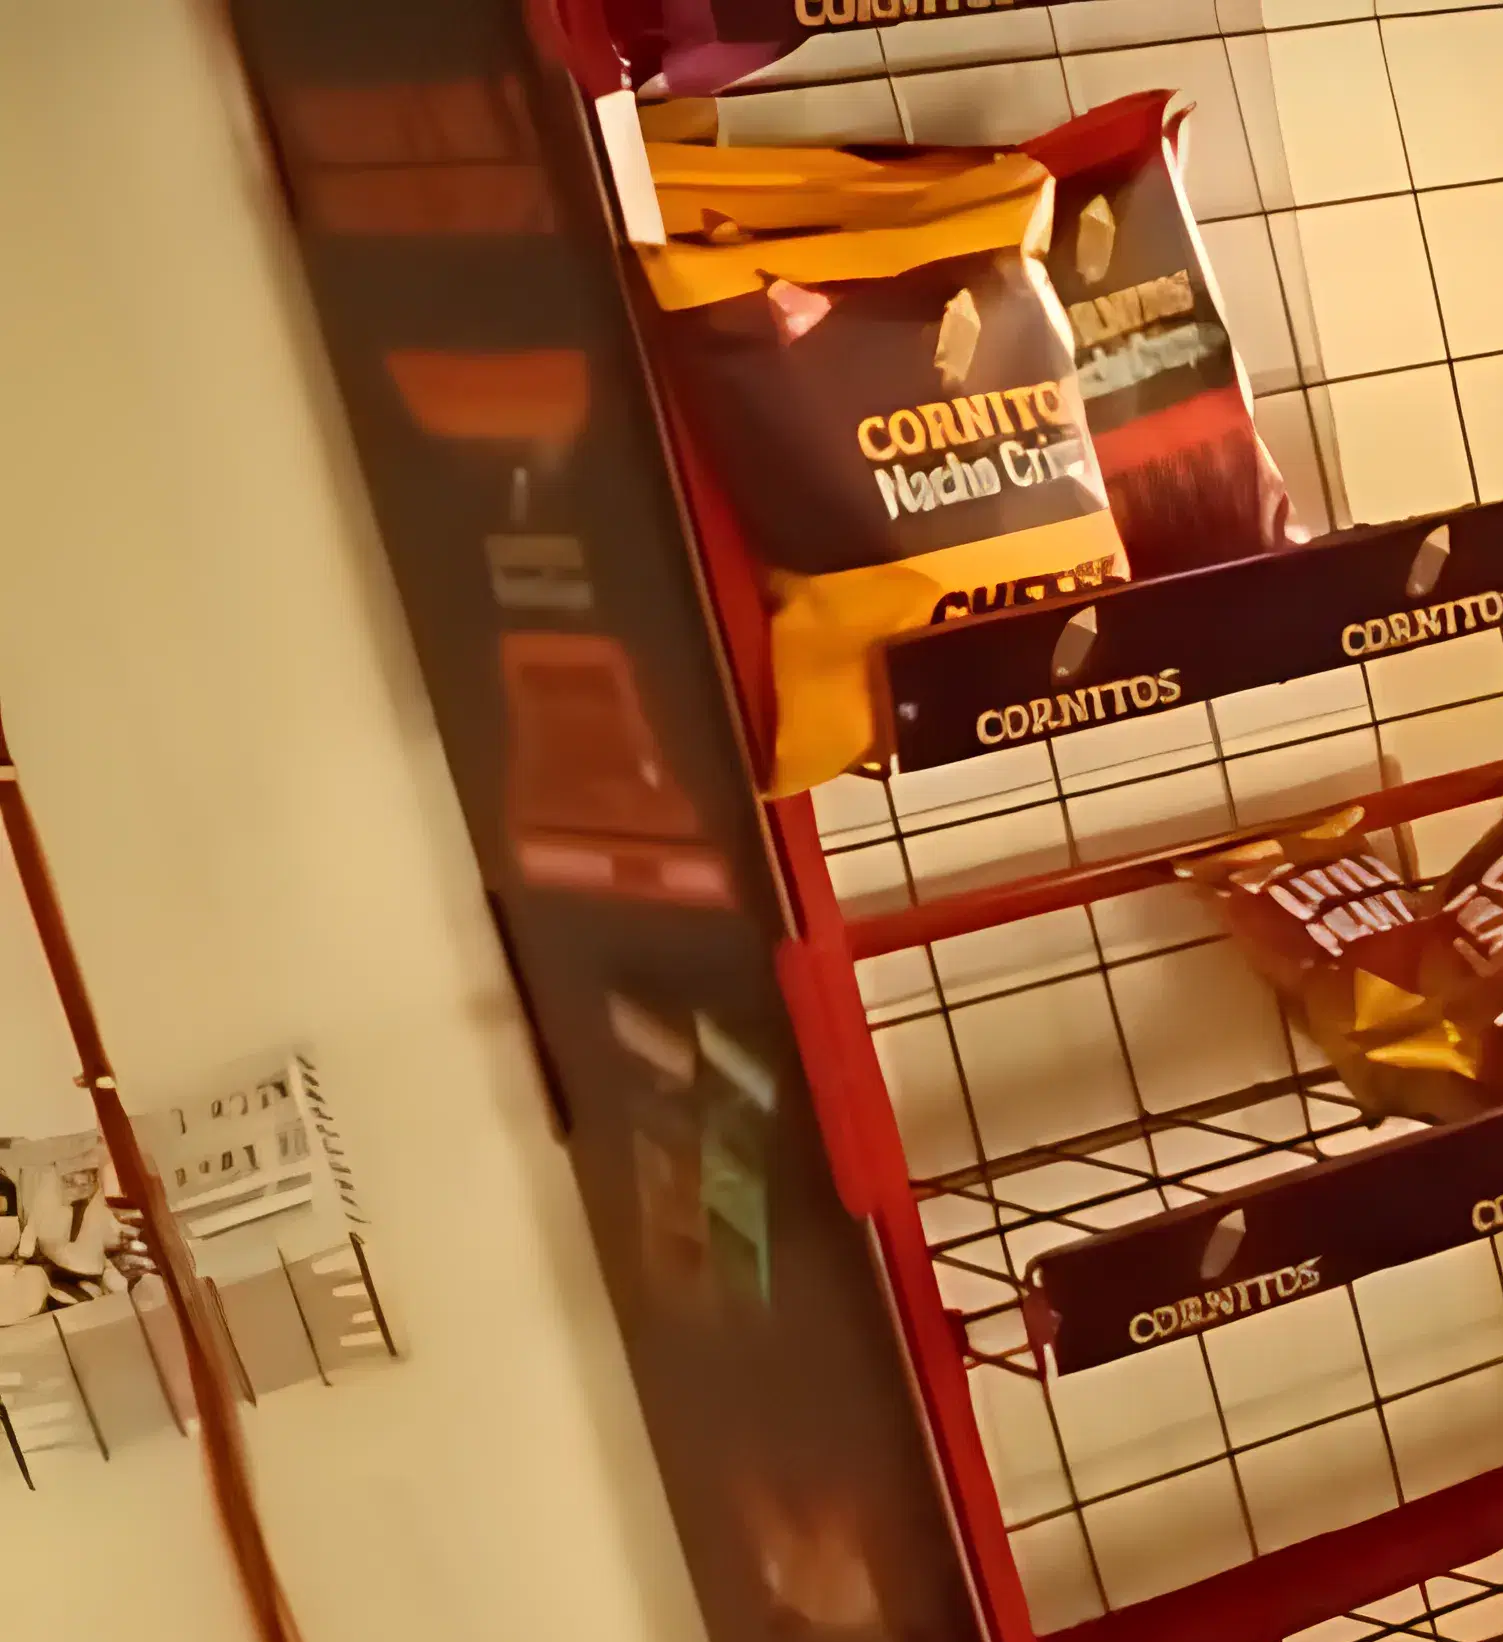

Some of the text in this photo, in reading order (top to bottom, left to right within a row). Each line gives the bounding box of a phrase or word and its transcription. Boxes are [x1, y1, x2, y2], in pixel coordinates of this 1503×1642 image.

[857, 380, 1062, 462] CORNITO
[977, 668, 1182, 745] CORNITOS
[1129, 1255, 1321, 1343] CORNITOS
